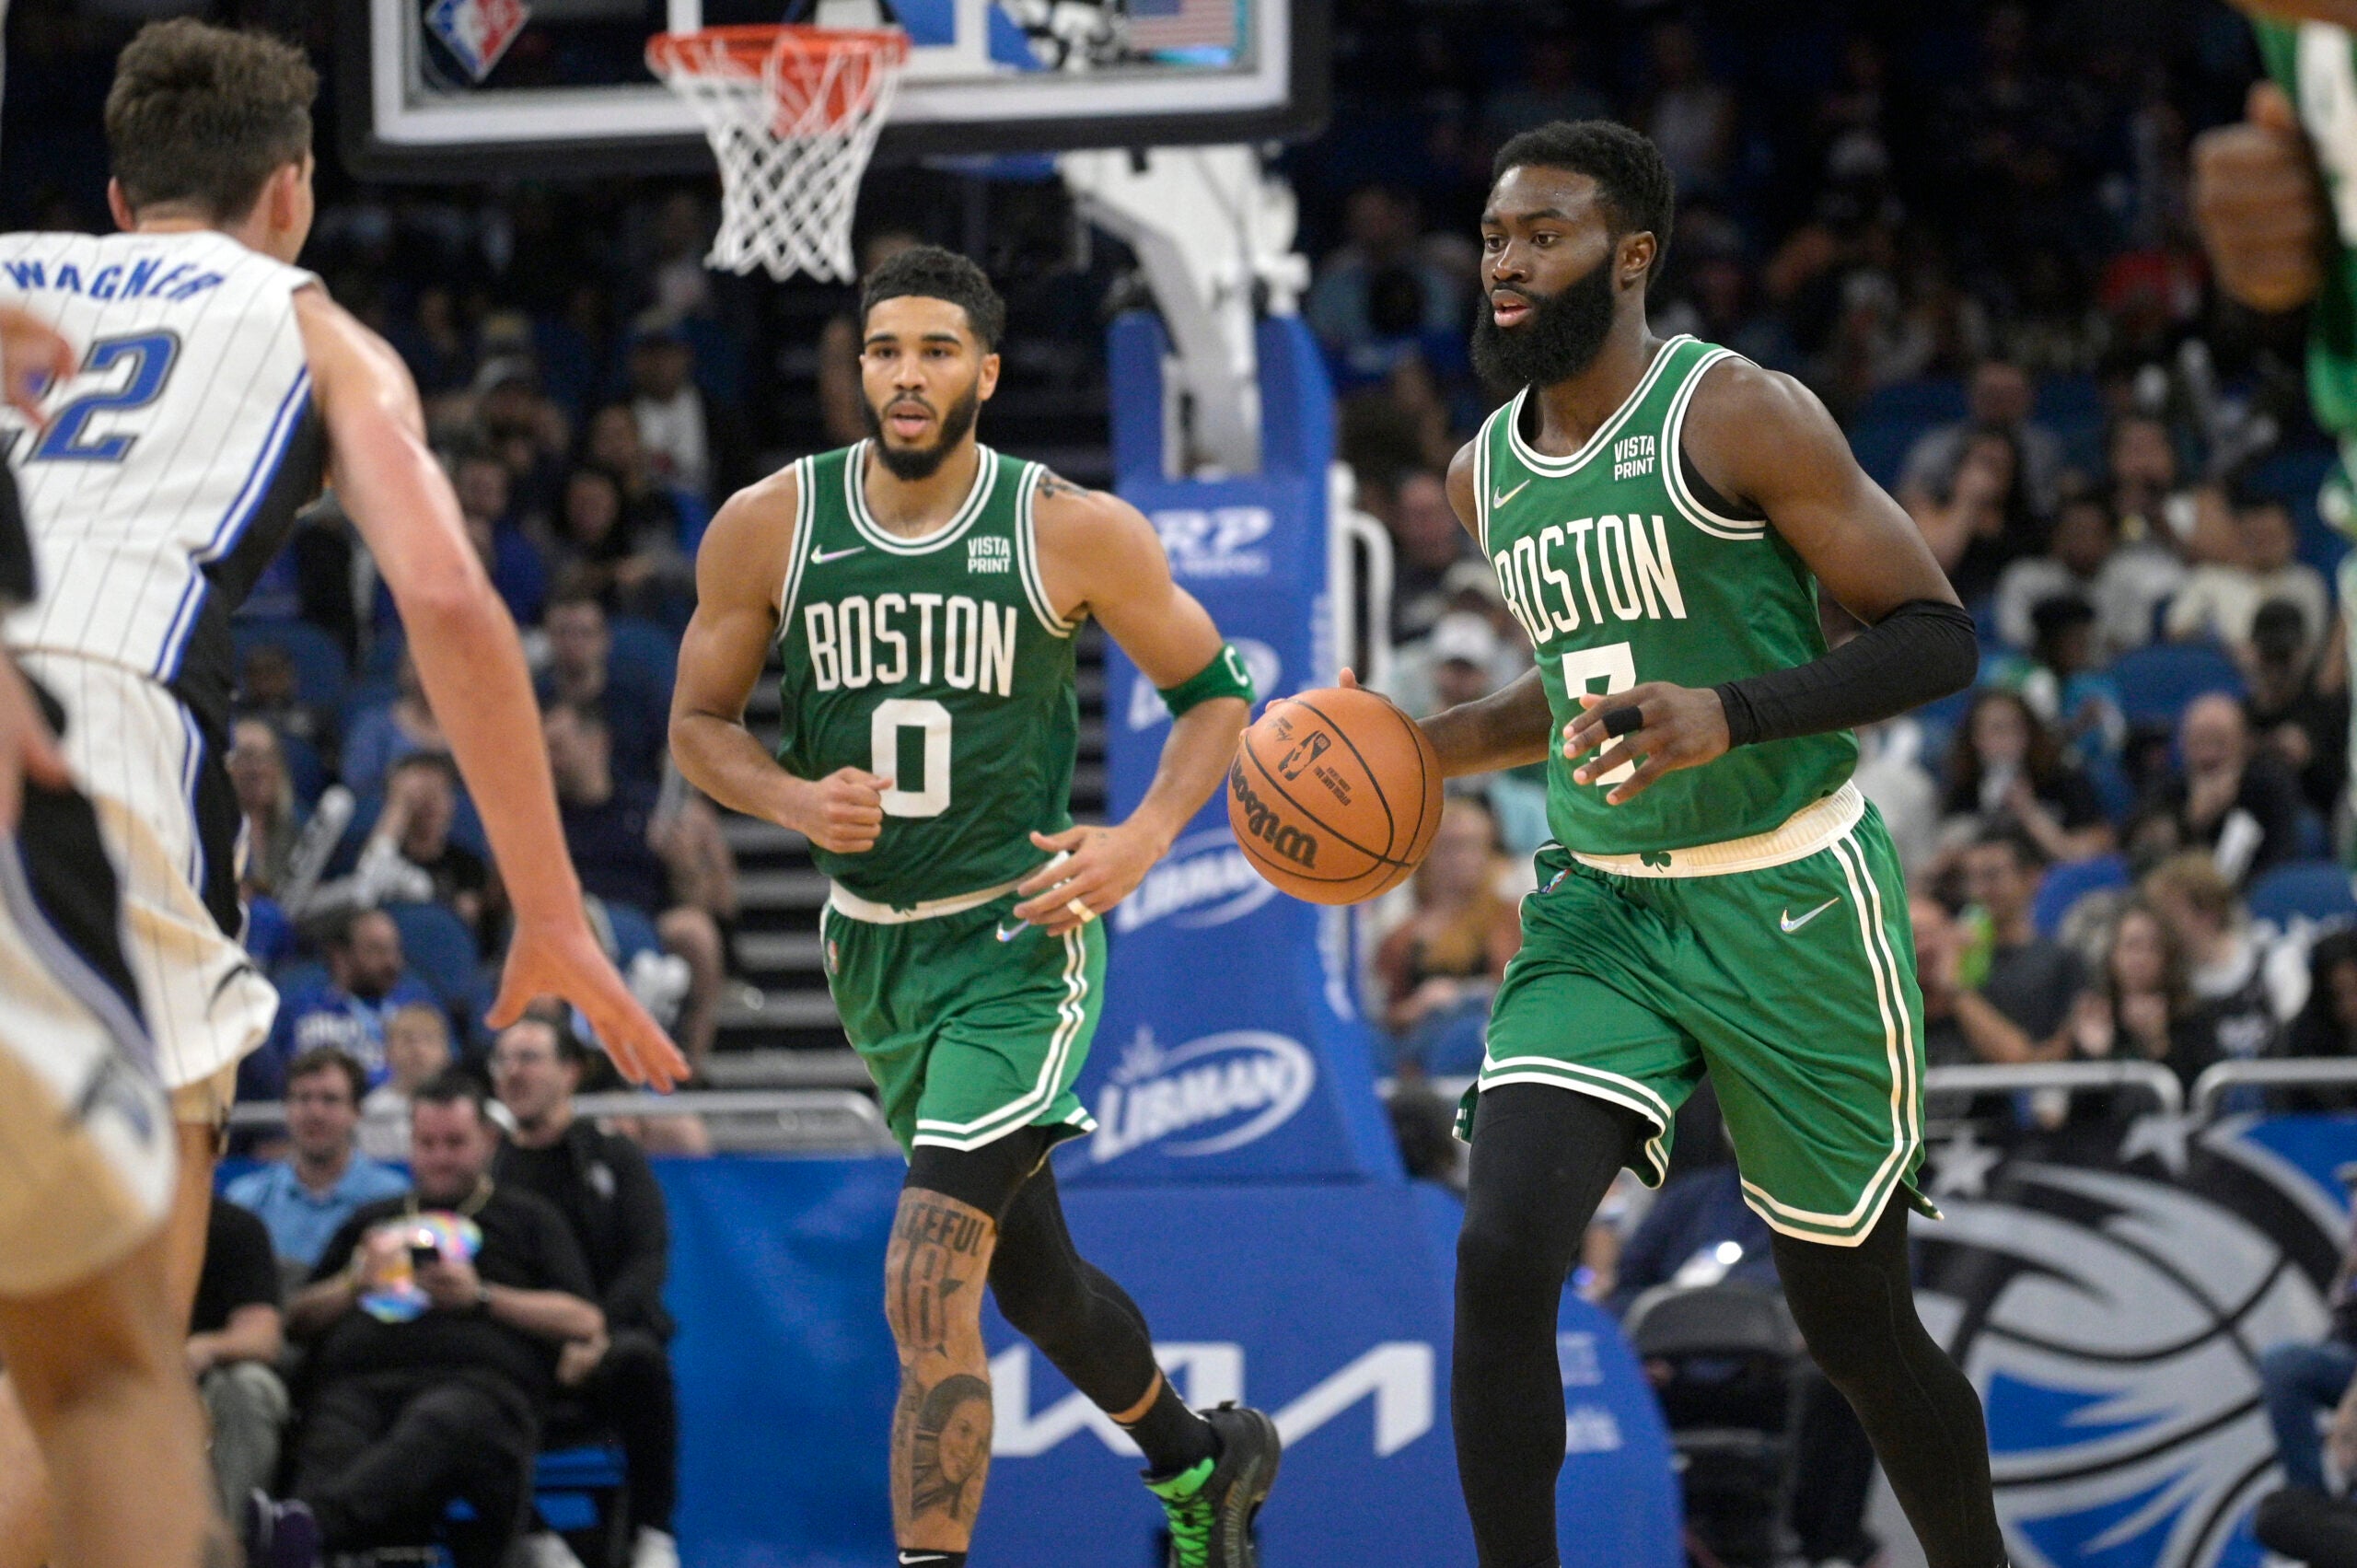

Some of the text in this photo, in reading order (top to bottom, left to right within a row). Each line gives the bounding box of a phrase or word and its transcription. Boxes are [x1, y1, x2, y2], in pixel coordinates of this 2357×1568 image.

[4, 257, 224, 302] WAGNER
[1614, 435, 1655, 463] VISTA
[1614, 456, 1655, 482] PRINT
[967, 536, 1011, 558] VISTA
[967, 557, 1011, 575] PRINT
[1493, 514, 1688, 650] BOSTON
[804, 592, 1017, 698] BOSTON
[1562, 642, 1637, 787] 7
[870, 698, 953, 819] 0
[1230, 754, 1317, 870] Wilson
